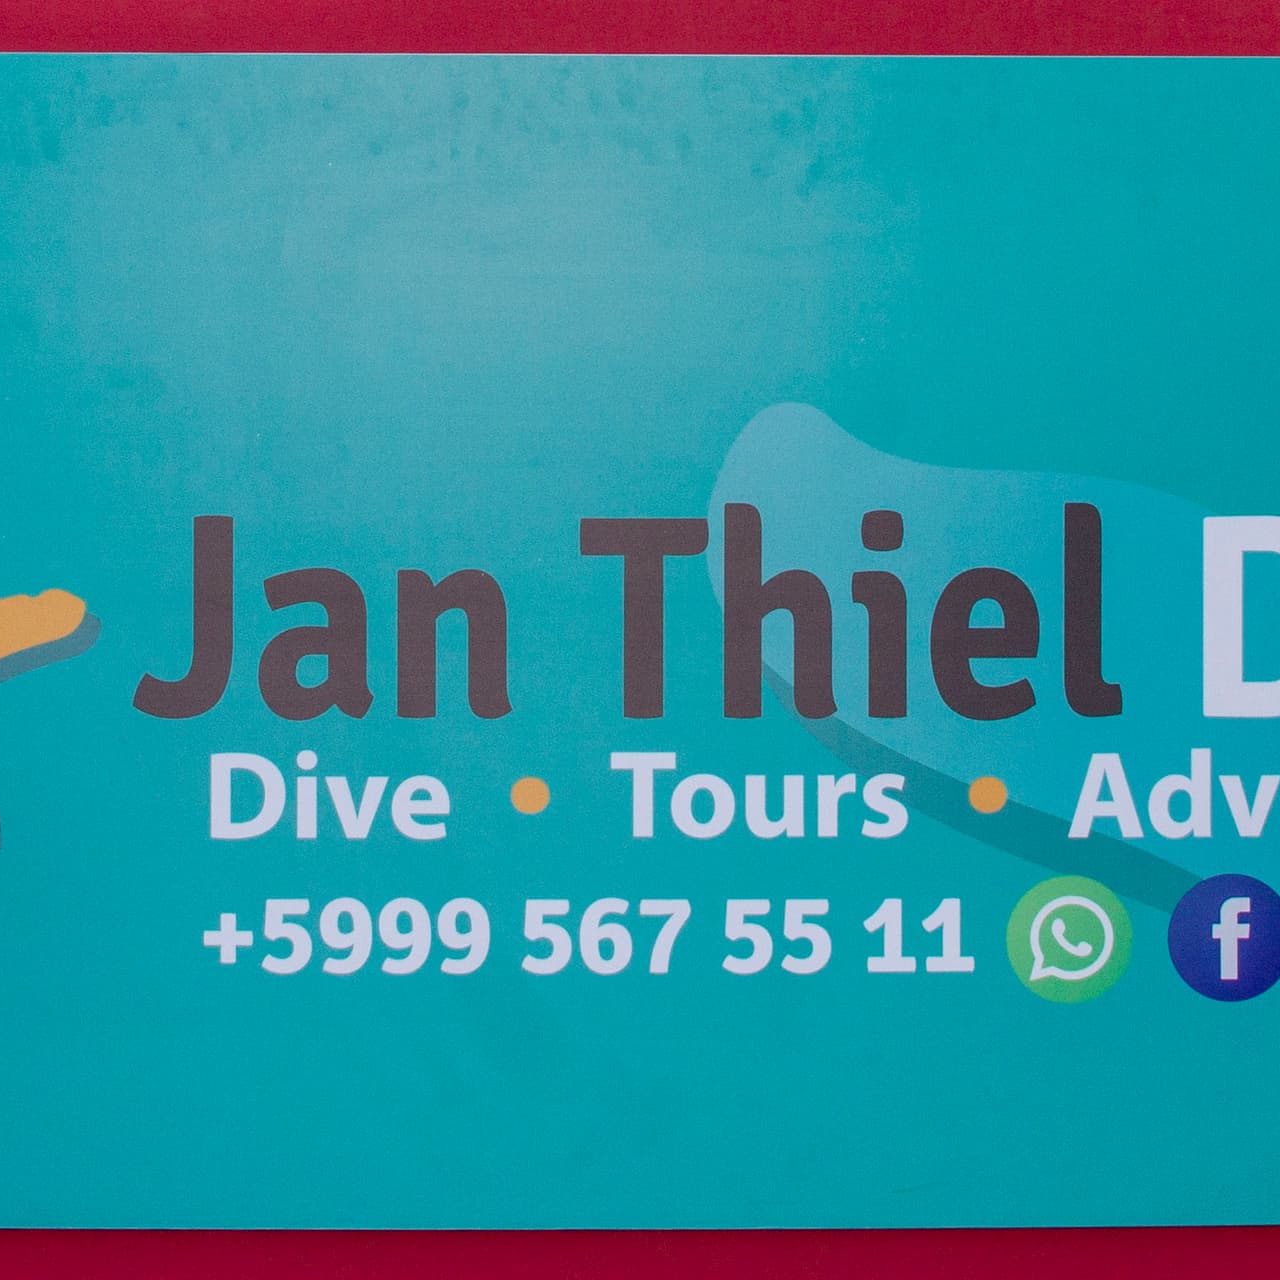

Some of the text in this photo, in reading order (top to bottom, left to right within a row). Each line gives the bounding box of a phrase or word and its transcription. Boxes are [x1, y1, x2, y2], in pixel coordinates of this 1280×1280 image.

[133, 515, 512, 721] Jan
[579, 503, 1122, 721] Thiel
[210, 751, 450, 841] Dive
[610, 752, 908, 840] Tours
[203, 898, 975, 975] +5999 567 55 11
